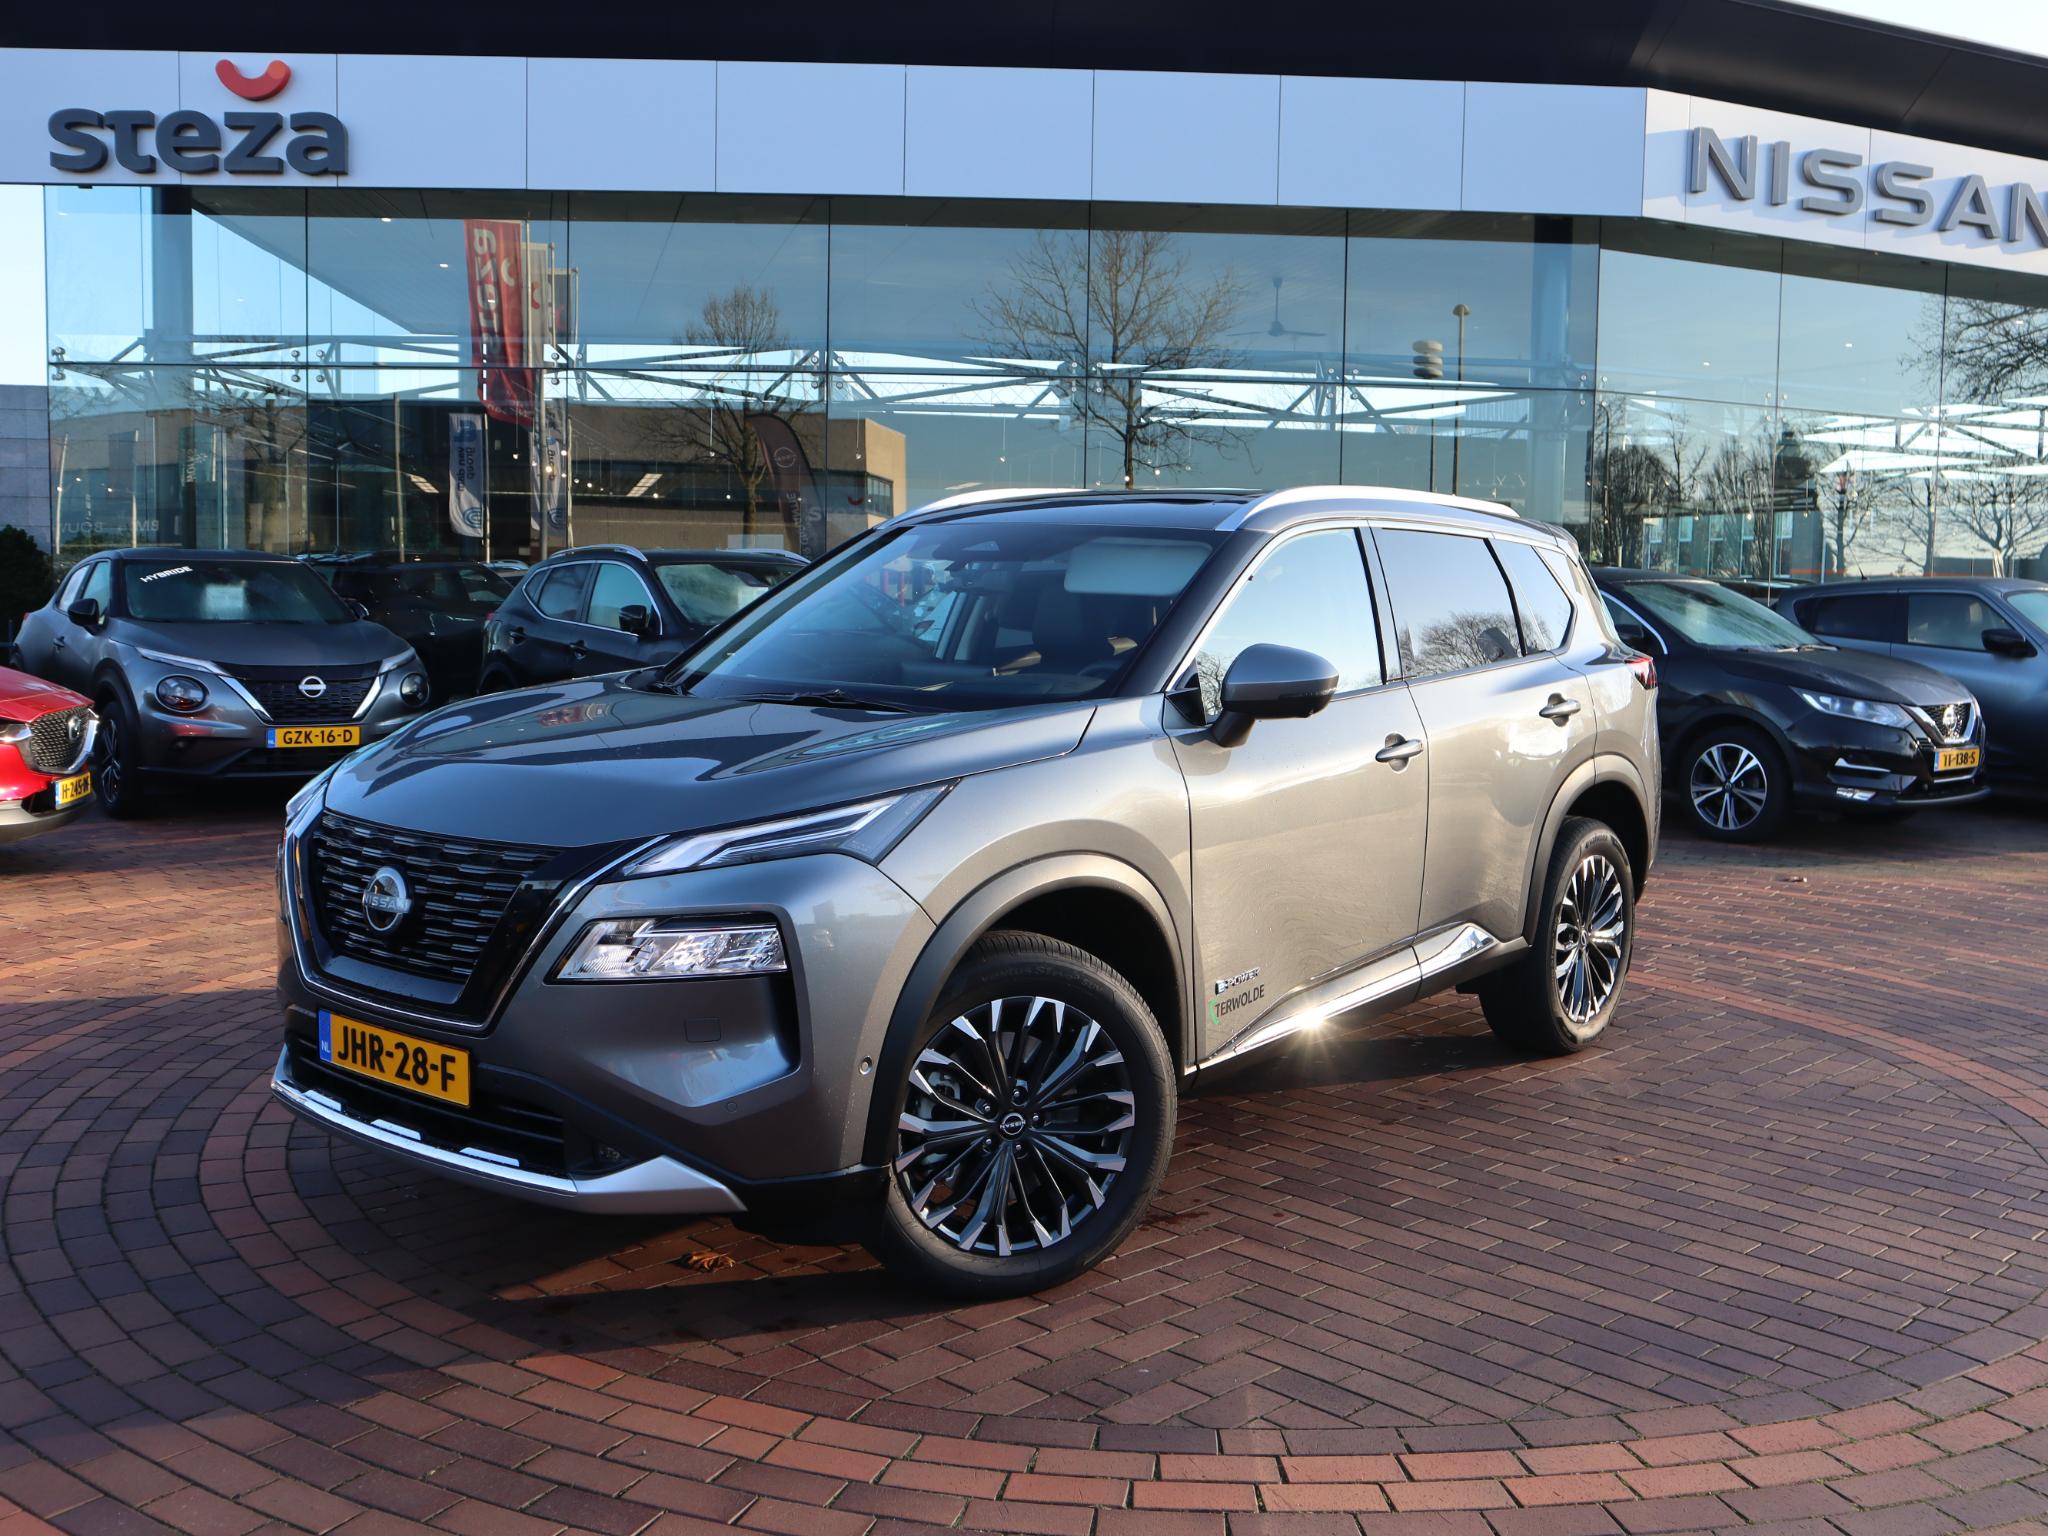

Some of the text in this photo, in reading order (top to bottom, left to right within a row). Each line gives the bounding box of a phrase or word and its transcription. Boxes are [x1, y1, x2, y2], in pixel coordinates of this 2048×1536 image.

[48, 108, 349, 176] steza
[140, 565, 193, 583] HYBRIDE
[283, 729, 353, 745] GZK-16-D
[363, 894, 411, 913] NISSAN
[1214, 984, 1265, 1018] TERWOLDE
[321, 1025, 456, 1092] NL JHR-28-F
